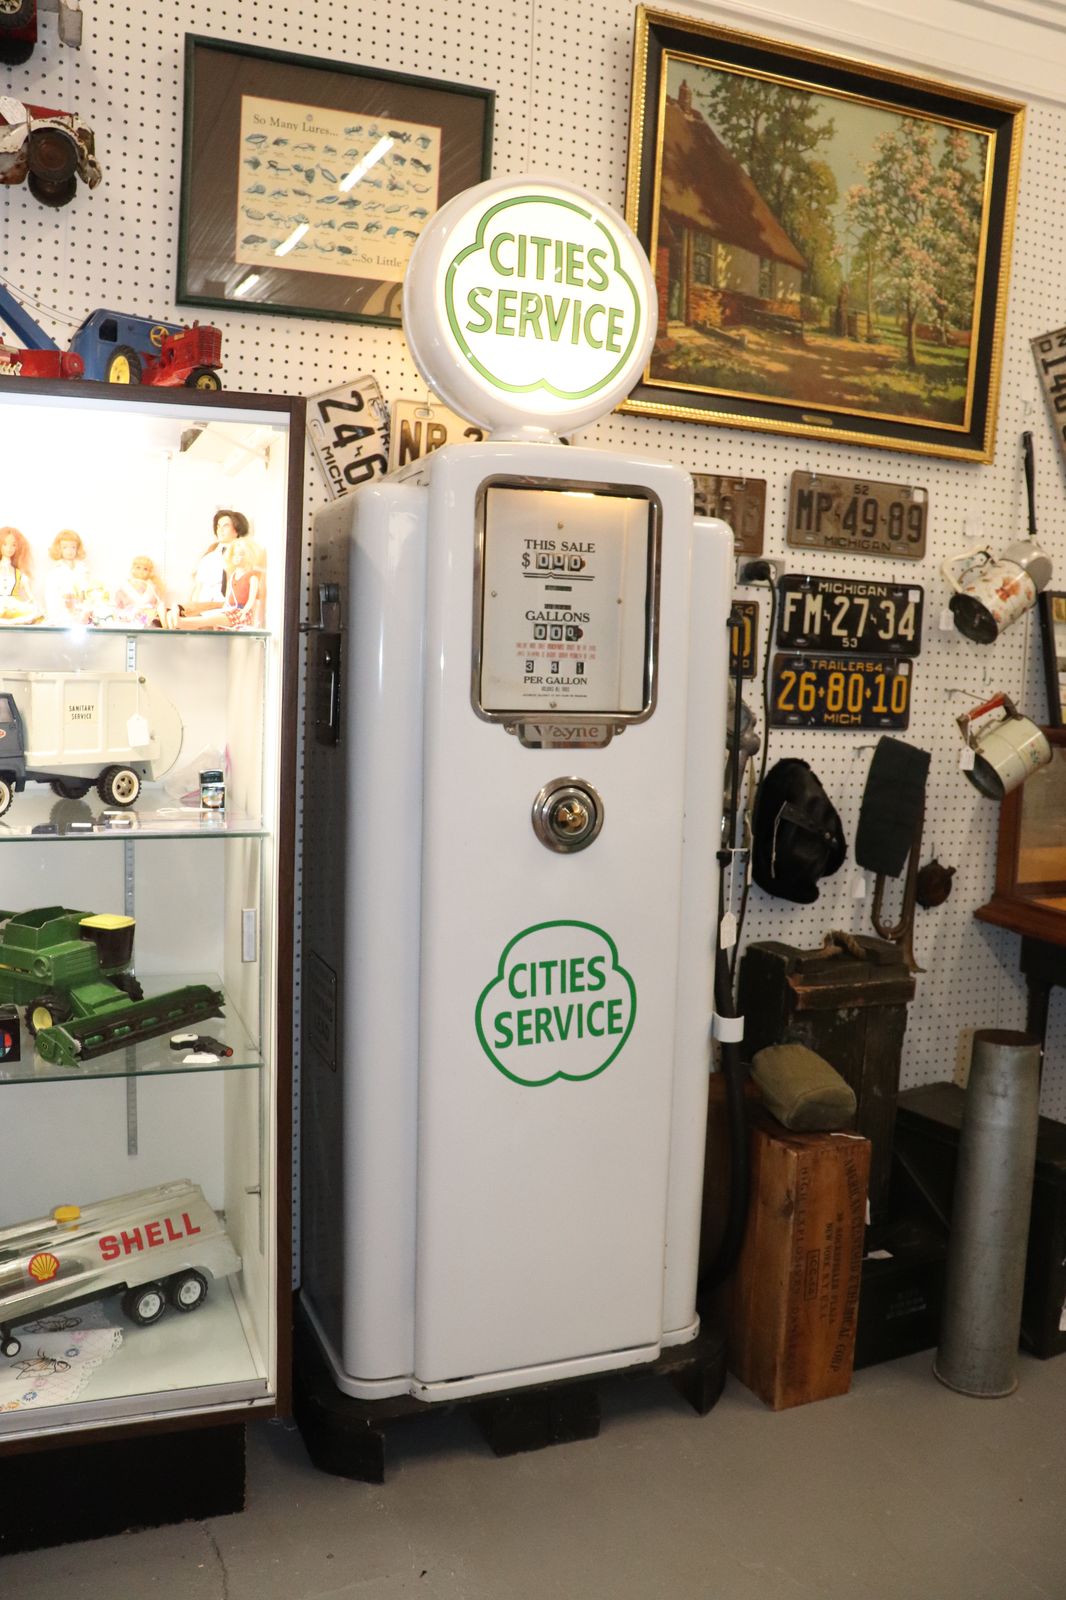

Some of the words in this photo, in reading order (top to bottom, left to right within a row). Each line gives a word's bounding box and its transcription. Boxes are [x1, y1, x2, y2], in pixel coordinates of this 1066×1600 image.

[253, 114, 266, 125] So
[270, 117, 299, 131] Many
[489, 231, 609, 292] CITIES
[466, 286, 624, 353] SERVICE
[854, 484, 869, 496] 52
[524, 539, 556, 551] THIS
[561, 541, 596, 553] SALE
[824, 535, 891, 551] MICHIGAN
[818, 582, 887, 597] MICHIGAN
[525, 610, 590, 623] GALLONS
[842, 637, 858, 649] 53
[523, 676, 543, 685] PER
[546, 677, 588, 686] GALLON
[69, 704, 94, 712] SANITARY
[823, 713, 862, 725] MICH
[533, 725, 599, 740] Wayne
[508, 956, 606, 999] CITIES
[494, 999, 623, 1049] SERVICE
[99, 1212, 201, 1261] SHELL
